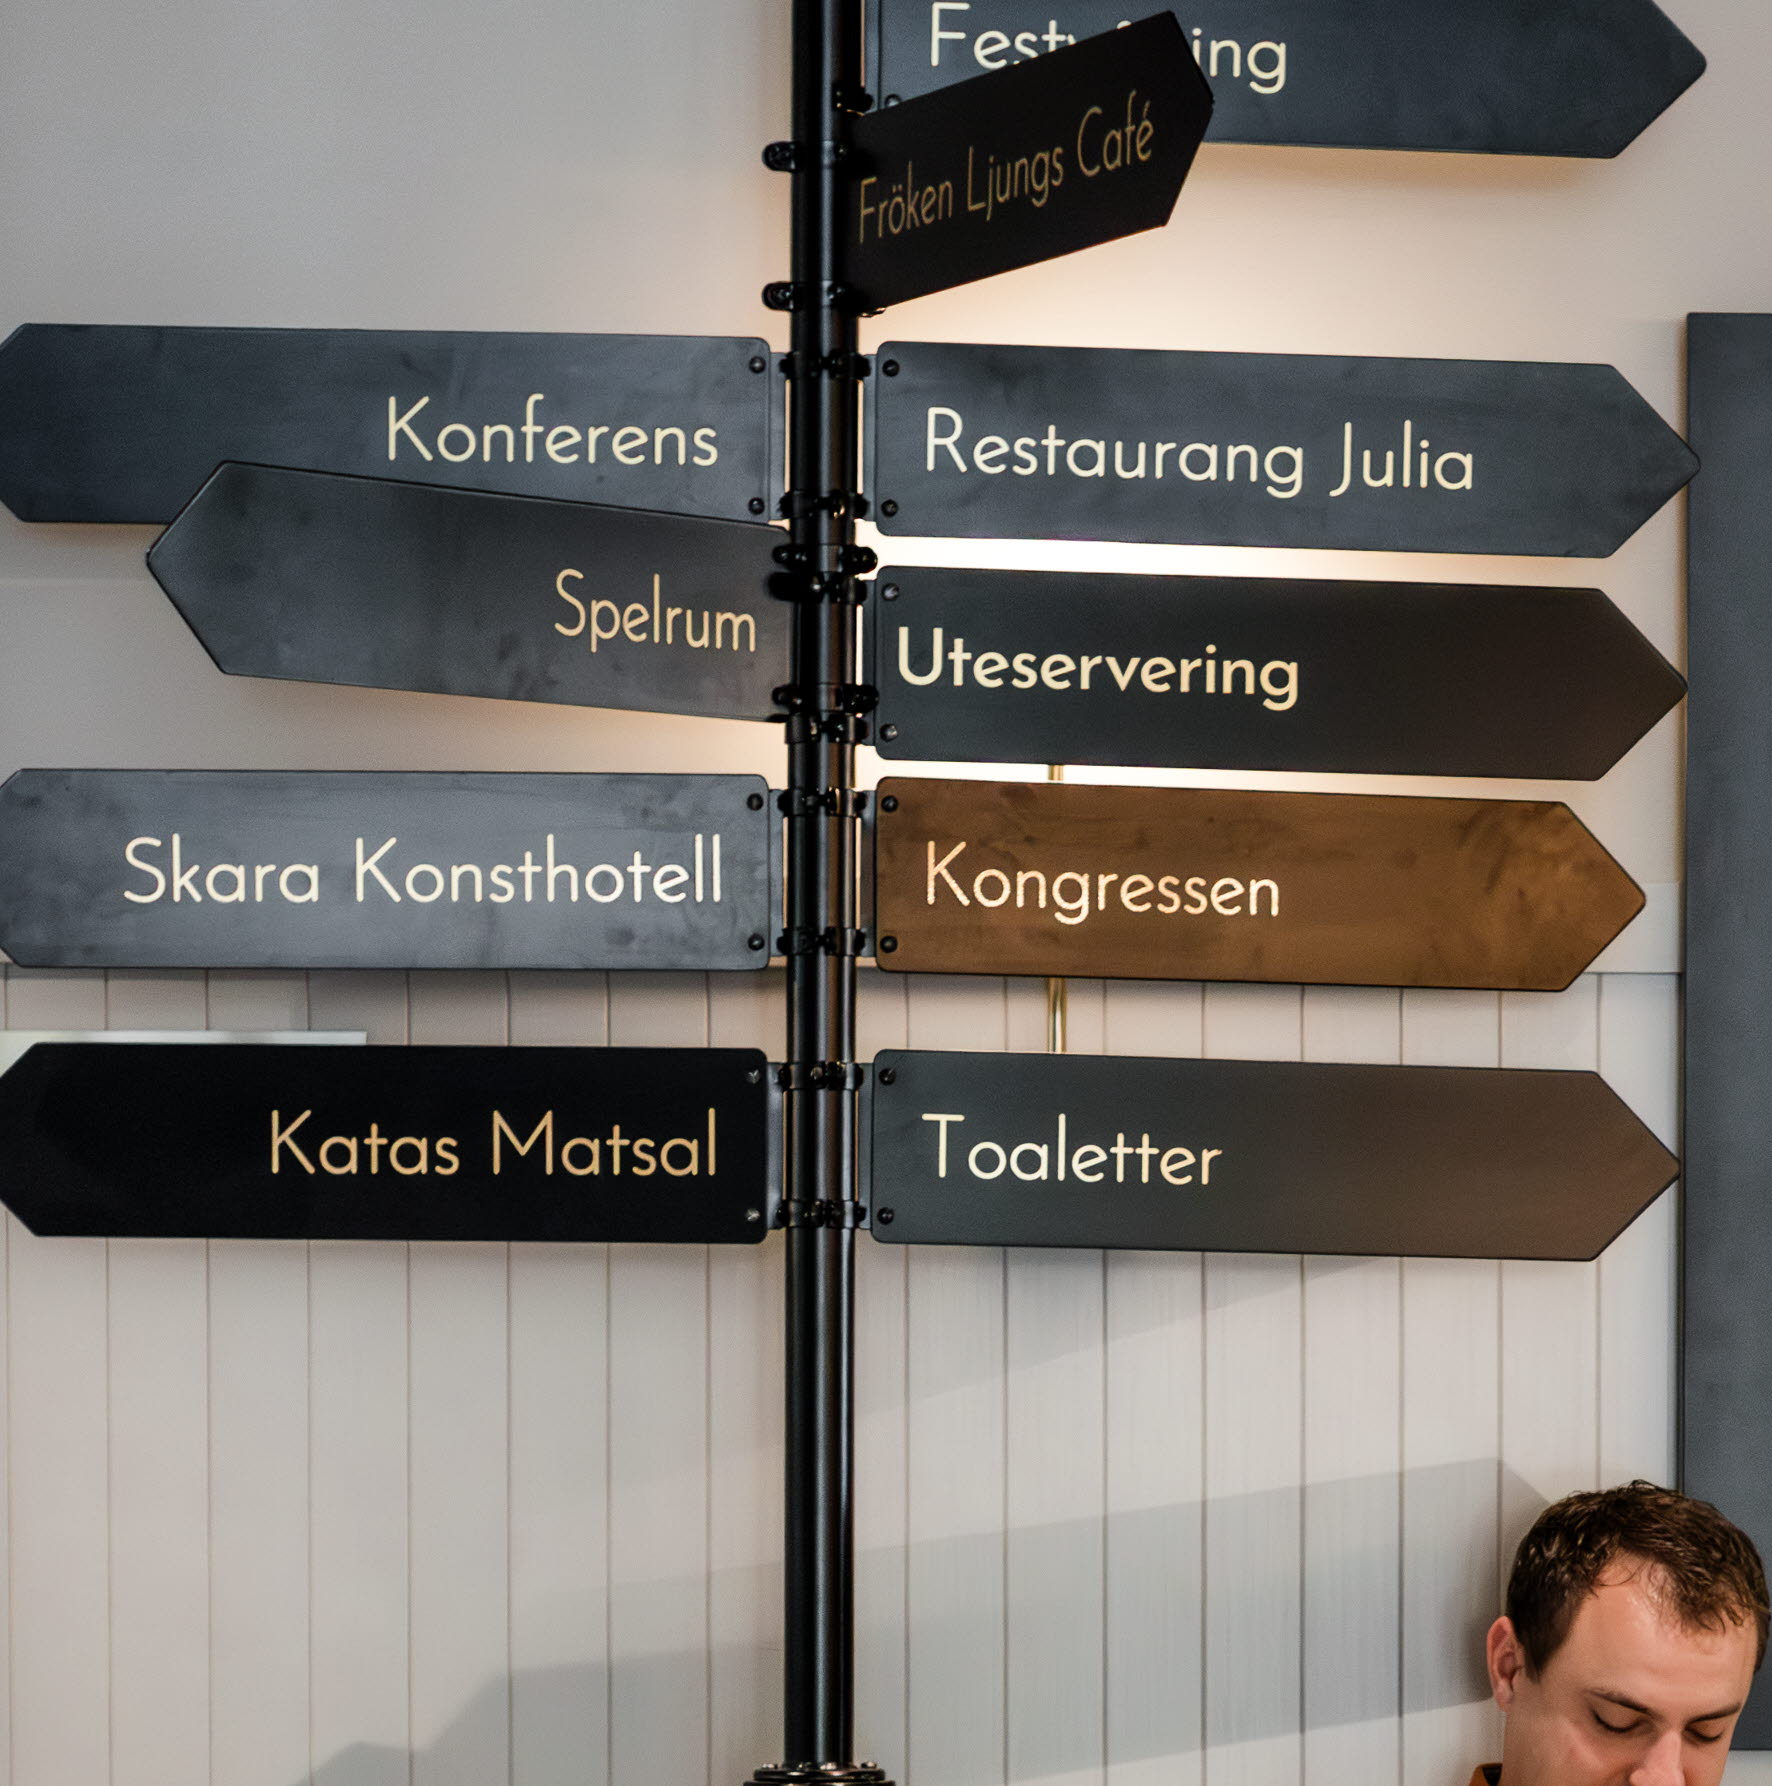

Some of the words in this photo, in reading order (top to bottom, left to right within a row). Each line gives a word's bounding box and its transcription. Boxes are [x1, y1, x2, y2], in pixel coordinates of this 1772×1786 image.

[930, 1, 1287, 94] Festing
[859, 160, 953, 245] Fröken
[967, 145, 1064, 221] Ljungs
[1076, 89, 1155, 178] Café
[387, 393, 719, 467] Konferens
[925, 406, 1305, 499] Restaurang
[1328, 419, 1474, 497] Julia
[553, 568, 757, 653] Spelrum
[897, 626, 1299, 712] Uteservering
[122, 833, 320, 904] Skara
[354, 833, 722, 904] Konsthotell
[925, 840, 1280, 926] Kongressen
[270, 1109, 460, 1176] Katas
[491, 1107, 716, 1177] Matsal
[921, 1113, 1224, 1186] Toaletter
